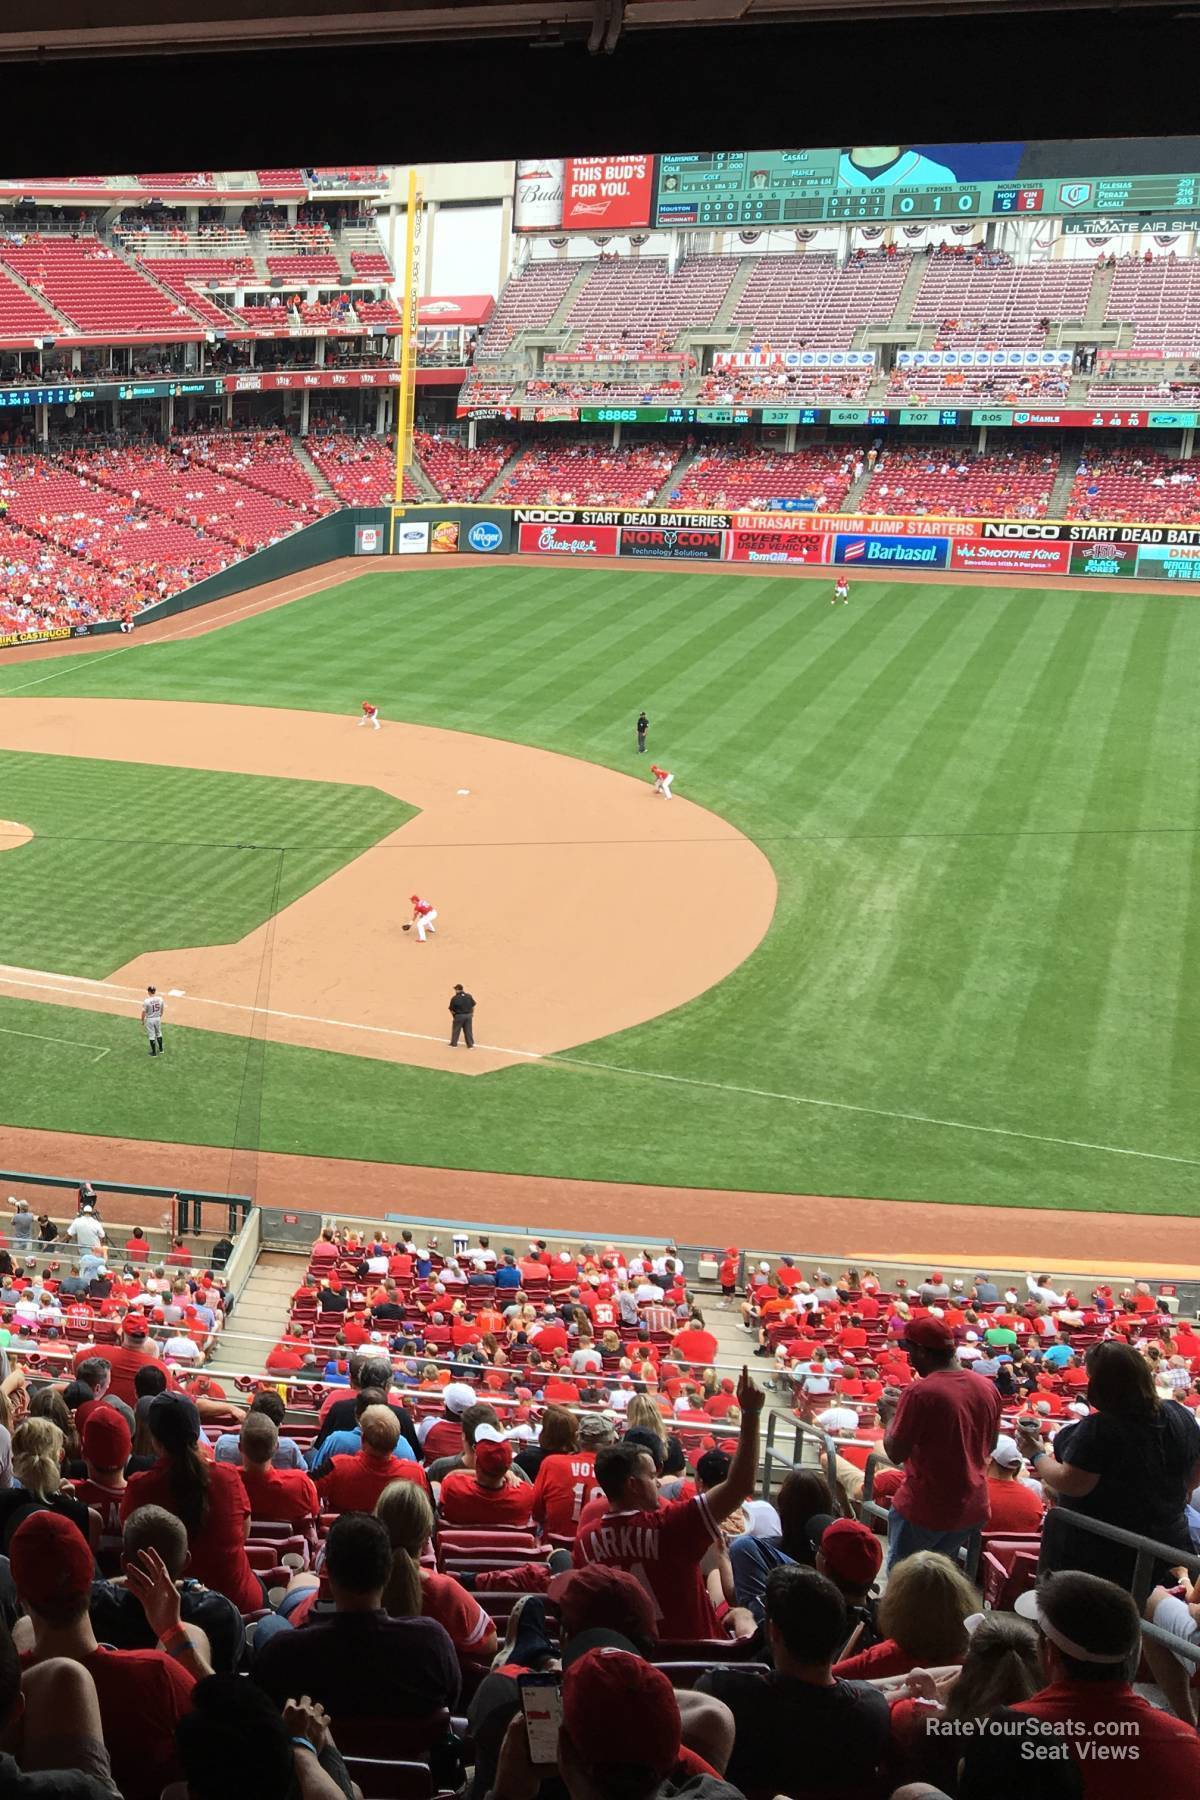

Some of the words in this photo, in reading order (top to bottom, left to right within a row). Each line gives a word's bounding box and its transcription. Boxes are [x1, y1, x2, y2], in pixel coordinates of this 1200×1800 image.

[572, 167, 601, 181] THIS
[605, 164, 646, 179] BUD'S
[571, 184, 597, 198] FOR
[600, 181, 631, 197] YOU.
[1098, 190, 1129, 198] PERAZA
[704, 203, 711, 211] 0
[715, 202, 721, 210] 0
[727, 201, 734, 209] 0
[745, 200, 752, 209] 0
[756, 200, 763, 208] 0
[831, 198, 838, 206] 0
[860, 196, 867, 205] 0
[875, 196, 880, 204] 1
[901, 198, 915, 212] 0
[933, 197, 942, 211] 1
[958, 195, 973, 210] 0
[1002, 199, 1012, 210] 5
[1025, 198, 1036, 208] 5
[703, 213, 710, 221] 0
[726, 212, 733, 220] 0
[744, 211, 751, 219] 0
[755, 210, 762, 218] 0
[843, 207, 850, 215] 6
[859, 206, 866, 215] 0
[874, 206, 881, 214] 7
[1065, 223, 1140, 234] ULTIMATE
[1141, 221, 1167, 232] AIR
[598, 409, 637, 421] $8865
[514, 510, 575, 523] NOCO
[582, 512, 620, 524] START
[623, 513, 656, 526] DEAD
[661, 514, 730, 528] BATTERIES.
[737, 515, 806, 530] ULTRASAFE
[812, 517, 864, 532] LITHIUM
[868, 519, 903, 534] JUMP
[907, 522, 977, 537] STARTERS.
[473, 527, 499, 546] Kroger
[538, 527, 597, 553] Chick-fil-A
[738, 534, 784, 544] OVER
[786, 535, 820, 544] 200
[985, 524, 1060, 539] NOCO
[1070, 527, 1117, 541] START
[1122, 528, 1162, 542] DEAD
[632, 547, 673, 558] Technology
[674, 549, 708, 557] Solutions
[737, 542, 766, 551] USED
[768, 544, 818, 552] VEHICLES
[977, 547, 1031, 559] SMOOTHIE
[1032, 549, 1060, 561] KING
[748, 552, 805, 563] TomGill.com
[1163, 561, 1192, 570] OFFICIAL
[19, 628, 71, 643] CASTRUCCI
[597, 1310, 613, 1323] 30
[1014, 1322, 1026, 1332] 14
